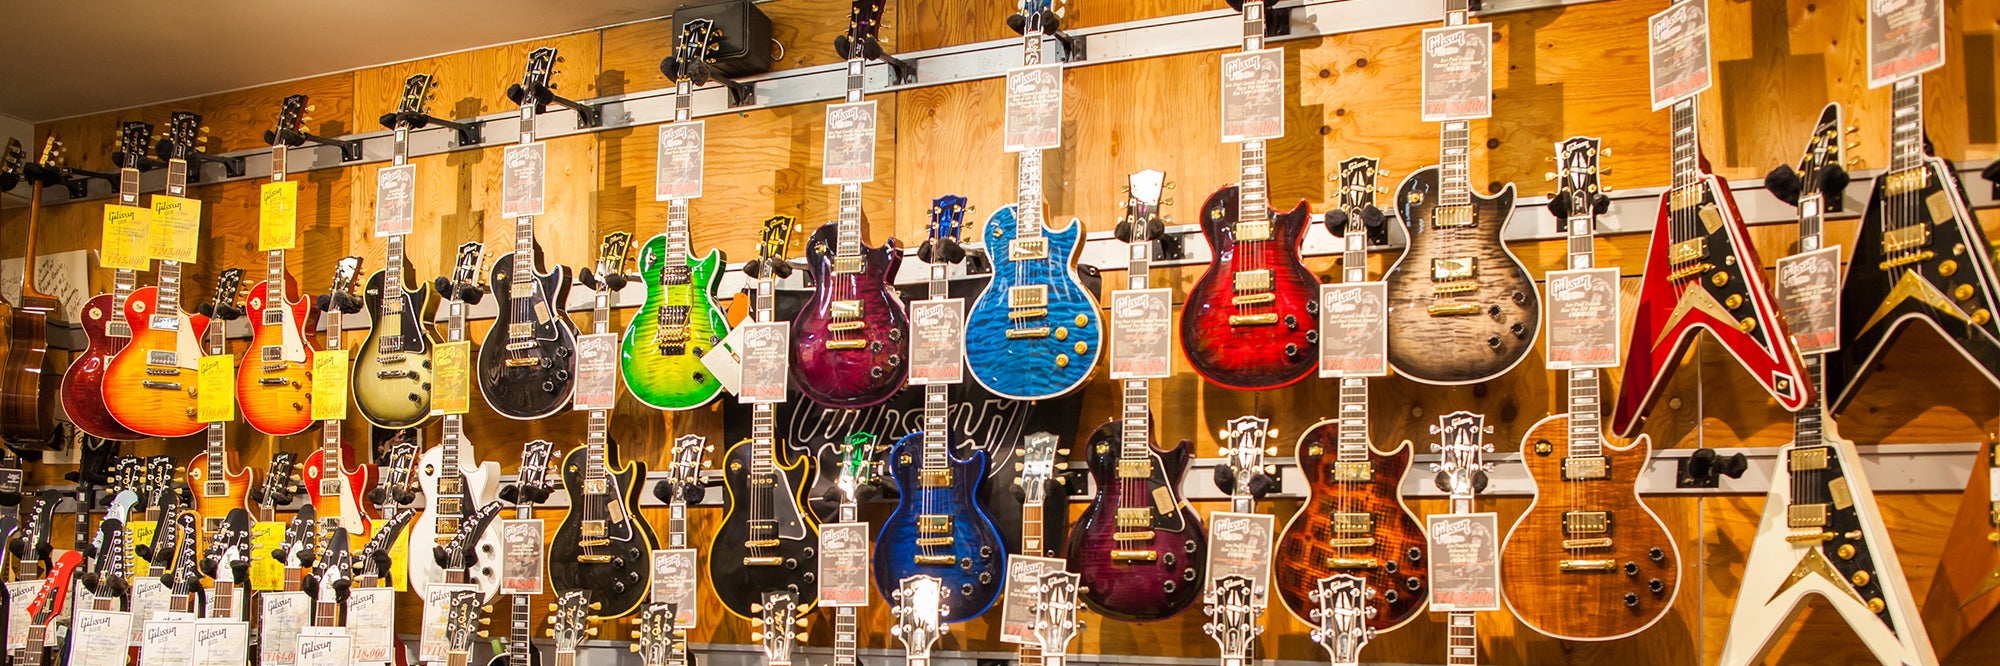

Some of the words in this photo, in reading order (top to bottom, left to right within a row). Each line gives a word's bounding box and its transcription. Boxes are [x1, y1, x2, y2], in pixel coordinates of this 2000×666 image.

[1427, 31, 1465, 57] Gibson
[1226, 55, 1260, 80] Gibson
[109, 210, 134, 224] Gibson
[155, 201, 182, 215] Gibson
[1551, 274, 1592, 301] Gibson
[1116, 294, 1149, 317] Gibson
[1325, 288, 1361, 312] Gibson
[1214, 518, 1250, 540] Gibson
[1432, 519, 1471, 544] Gibson
[1013, 562, 1044, 580] Gibson
[10, 585, 35, 602] Gibson
[137, 583, 162, 598] Gibson
[430, 590, 451, 607] Gibs
[268, 598, 292, 615] Gibson
[81, 617, 111, 632] Gibson
[148, 626, 177, 644] Gibson
[198, 628, 227, 646] Gibson
[301, 641, 332, 659] Gibson
